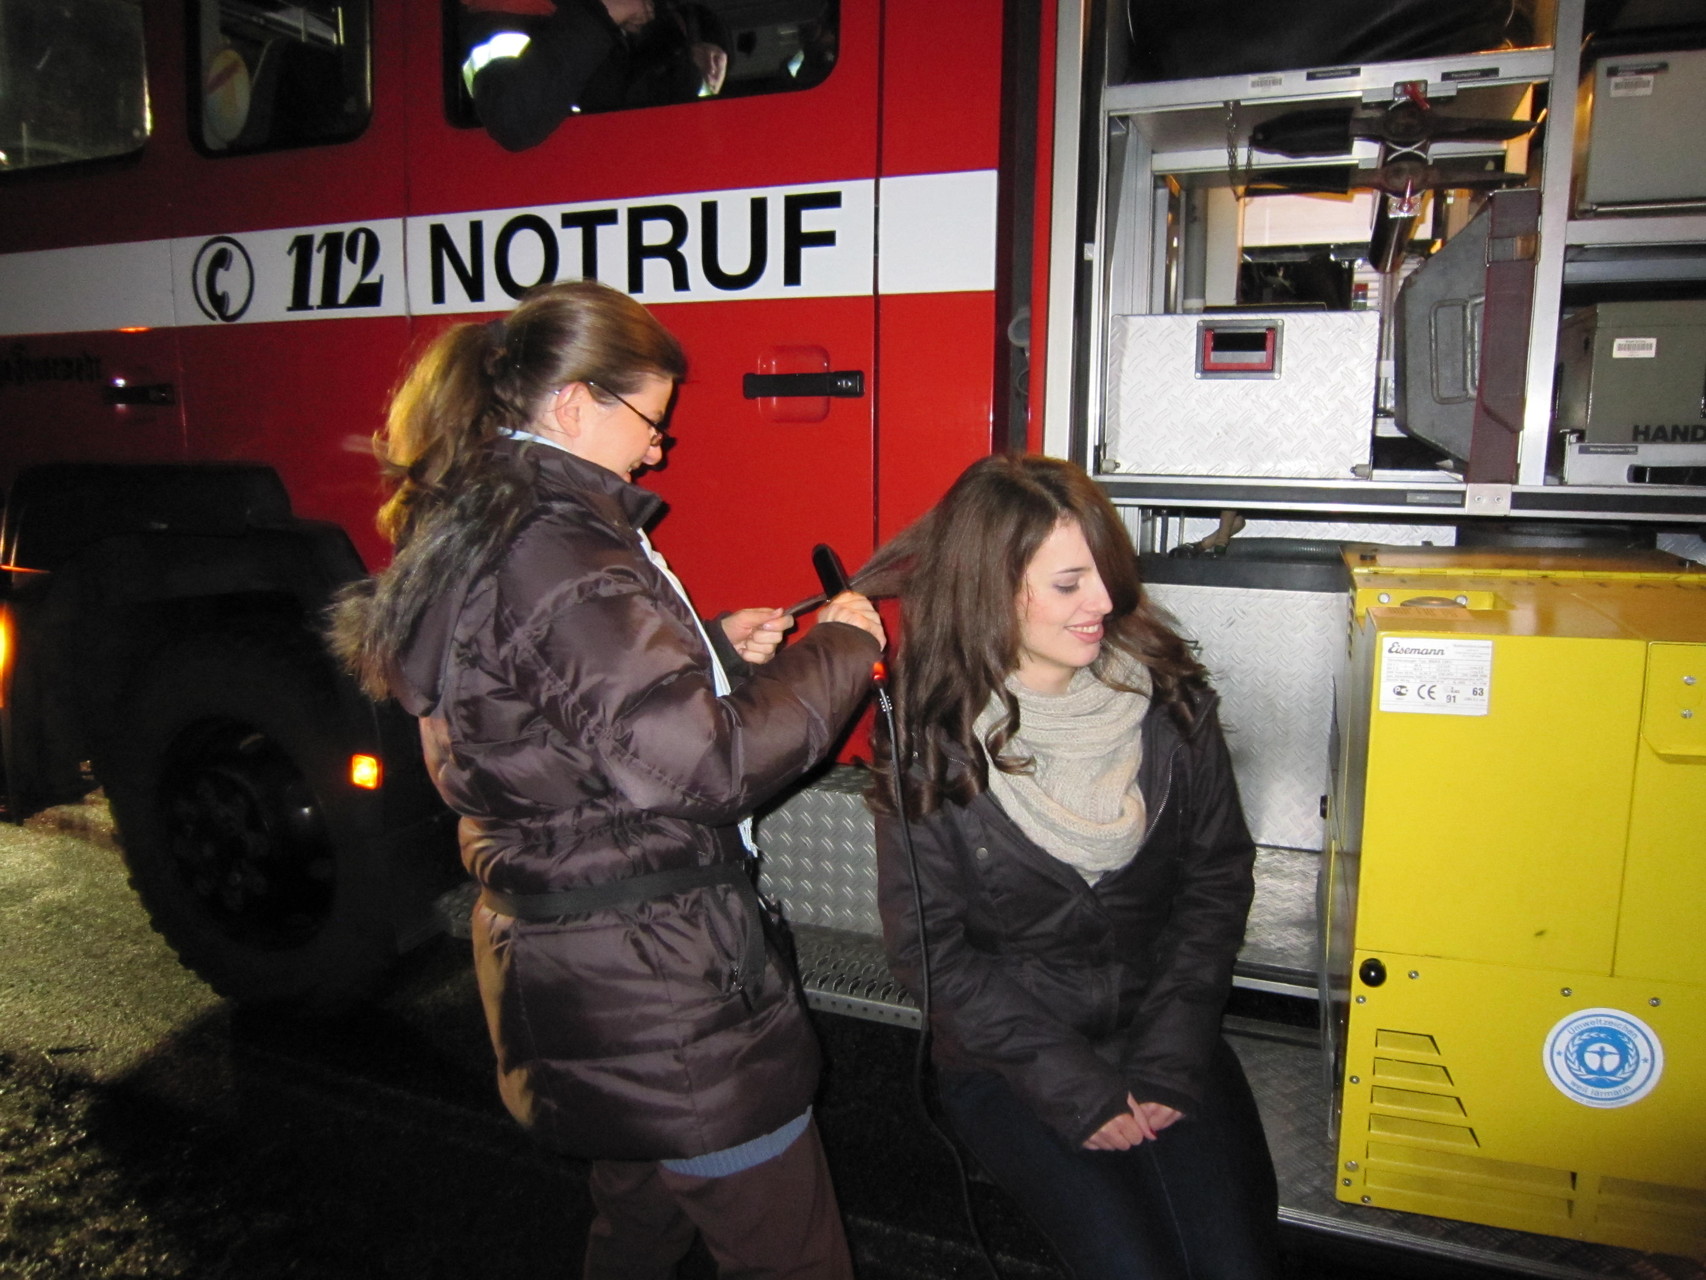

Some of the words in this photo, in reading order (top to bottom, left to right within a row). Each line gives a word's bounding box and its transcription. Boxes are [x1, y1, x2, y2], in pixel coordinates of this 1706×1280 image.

[287, 226, 384, 312] 112
[430, 190, 843, 305] NOTRUF
[1388, 641, 1445, 656] Eisemann
[1417, 684, 1437, 700] CE
[1446, 695, 1456, 703] 91
[1472, 687, 1484, 696] 63
[1567, 1017, 1638, 1039] Umweltzeichen
[1570, 1080, 1589, 1093] weil
